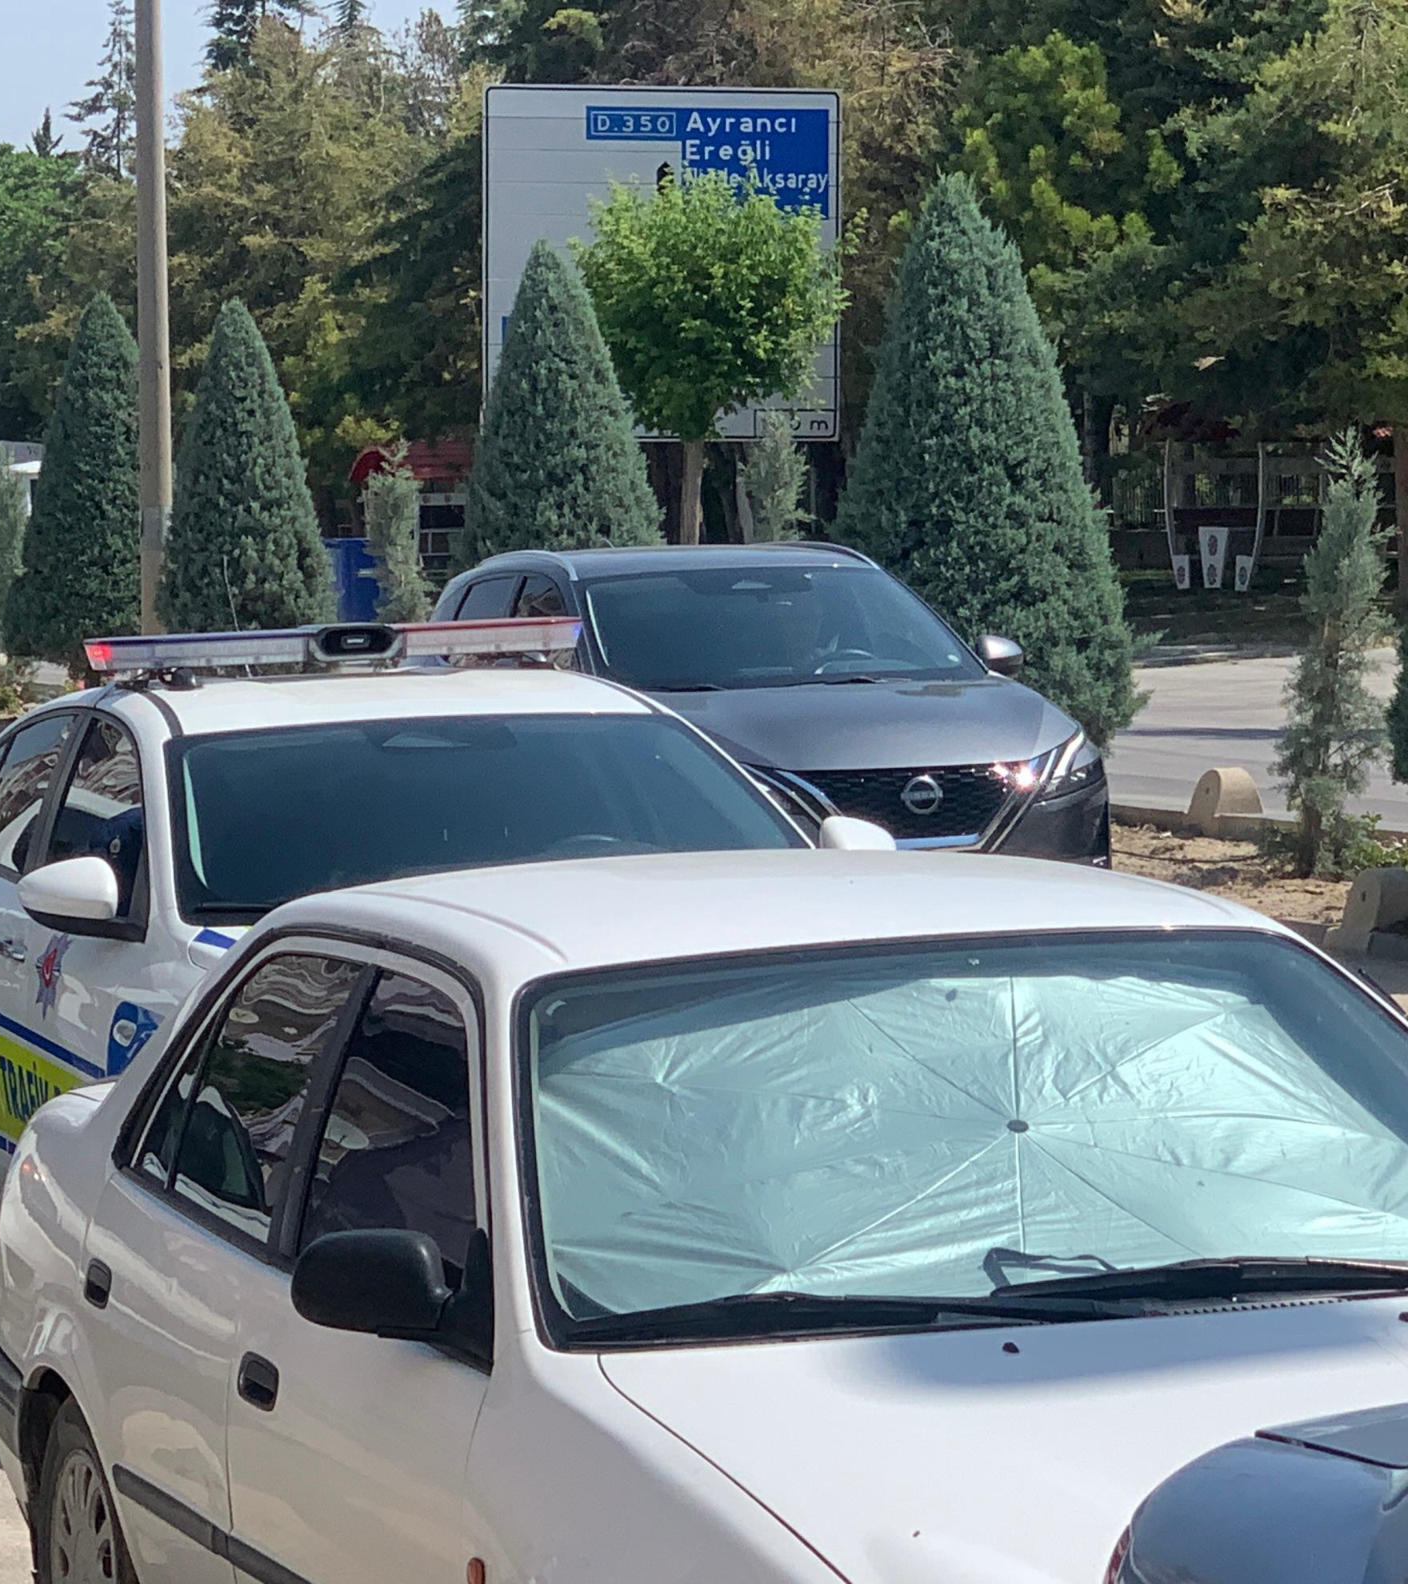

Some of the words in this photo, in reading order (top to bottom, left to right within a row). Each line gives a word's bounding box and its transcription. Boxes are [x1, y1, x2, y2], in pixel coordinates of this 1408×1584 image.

[597, 116, 670, 133] D.350
[686, 111, 796, 137] Ayrancı
[685, 140, 770, 165] Ereğli
